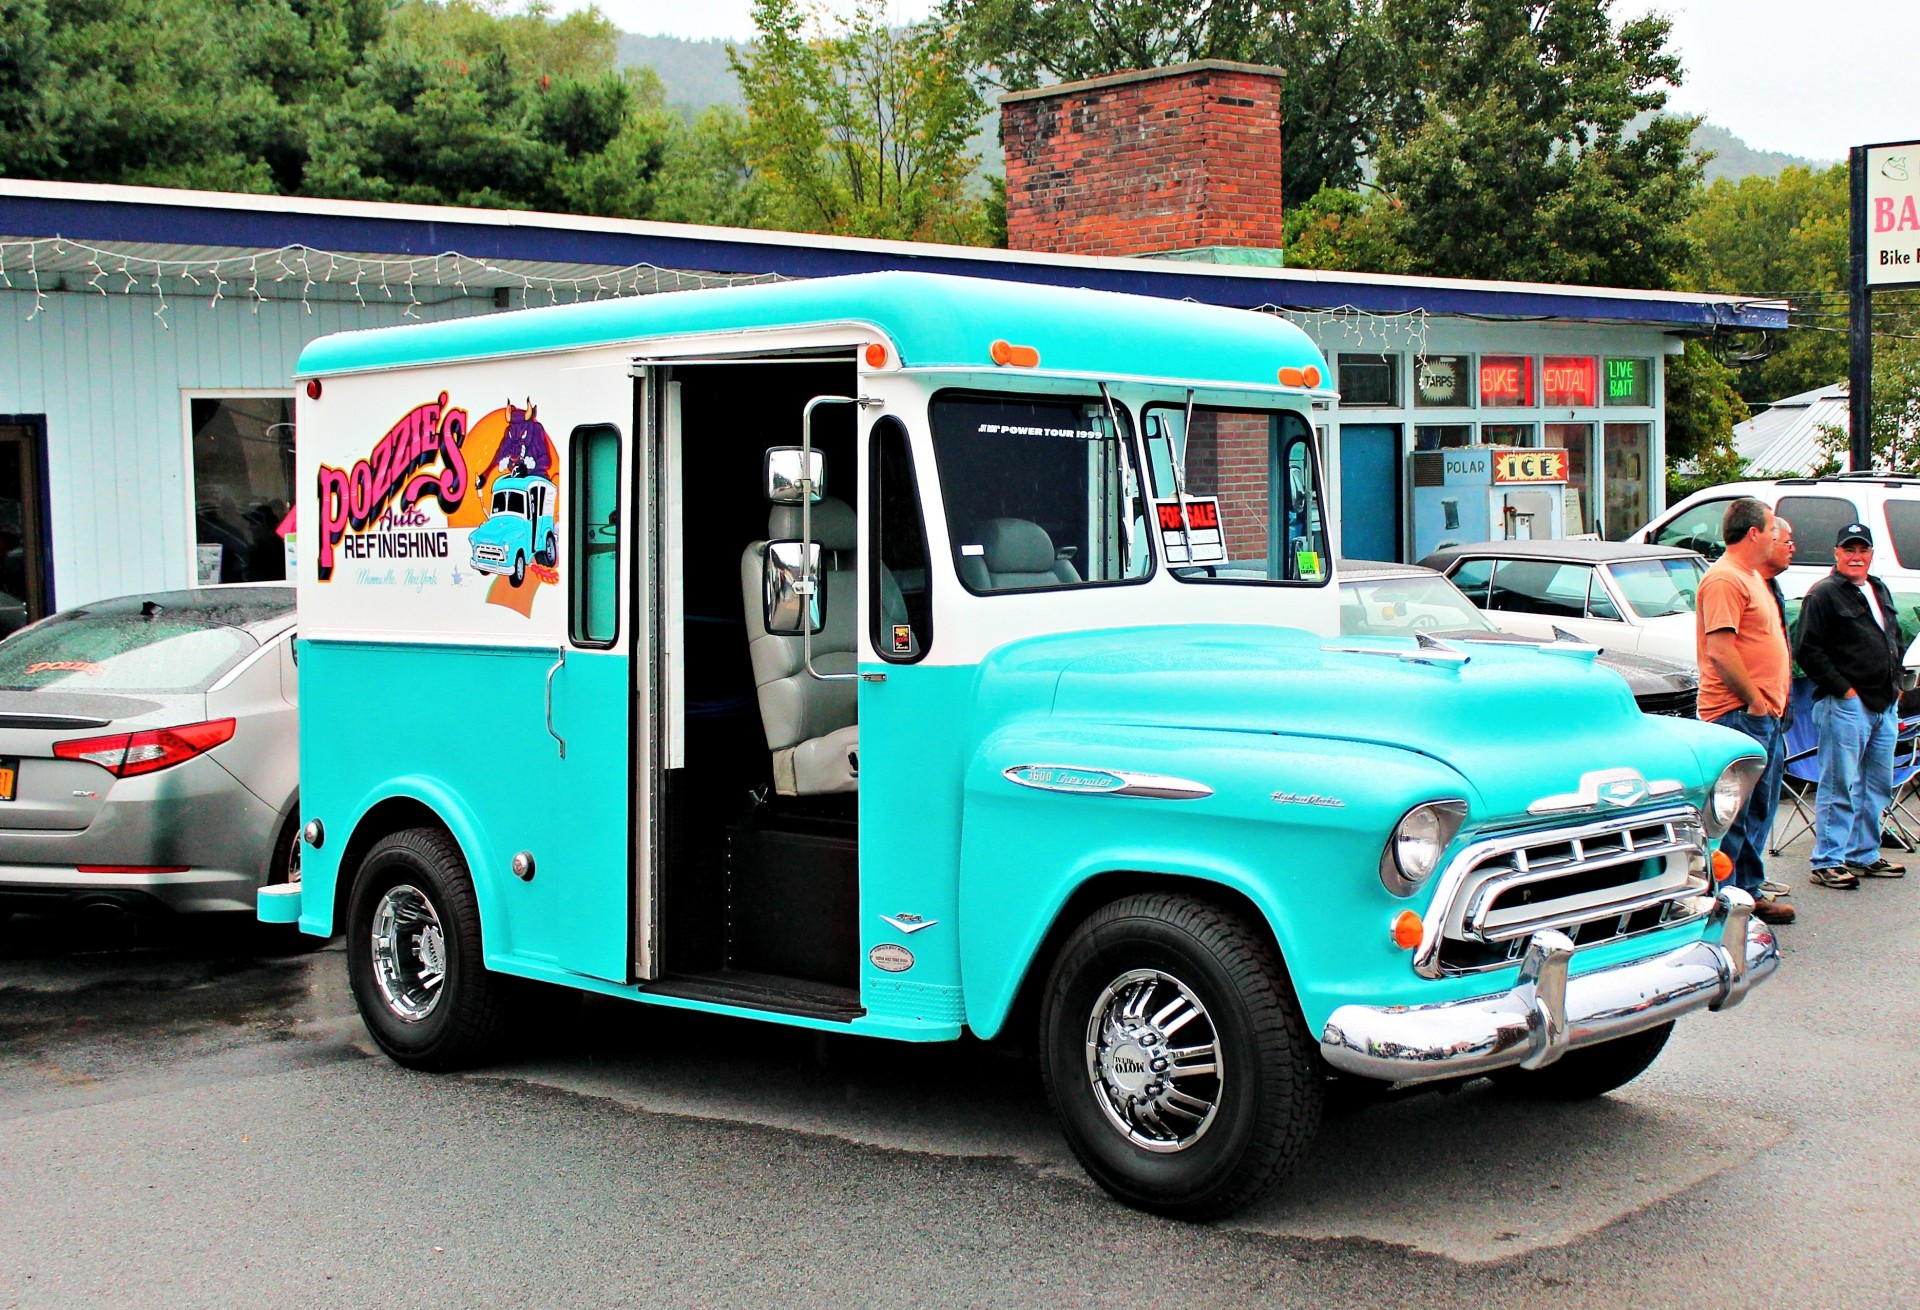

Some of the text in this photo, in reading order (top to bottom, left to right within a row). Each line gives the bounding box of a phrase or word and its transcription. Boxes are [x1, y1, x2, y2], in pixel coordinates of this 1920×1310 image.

[1880, 249, 1910, 265] Bike
[1607, 361, 1633, 378] LIVE
[1425, 375, 1453, 388] TARPS
[1482, 369, 1586, 392] BIKE ENTAL
[1610, 379, 1633, 397] BAIT
[1001, 425, 1043, 436] POWER
[1044, 428, 1074, 438] TOUR
[1076, 430, 1103, 440] 1999
[1446, 461, 1485, 474] POLAR
[1508, 456, 1553, 477] ICE
[318, 389, 468, 583] POZZIE'S
[379, 505, 430, 531] Auto
[1158, 504, 1218, 529] FOR SALE
[344, 531, 448, 559] REFINISHING
[1028, 770, 1053, 782] 3600
[1115, 1062, 1145, 1073] MOTO
